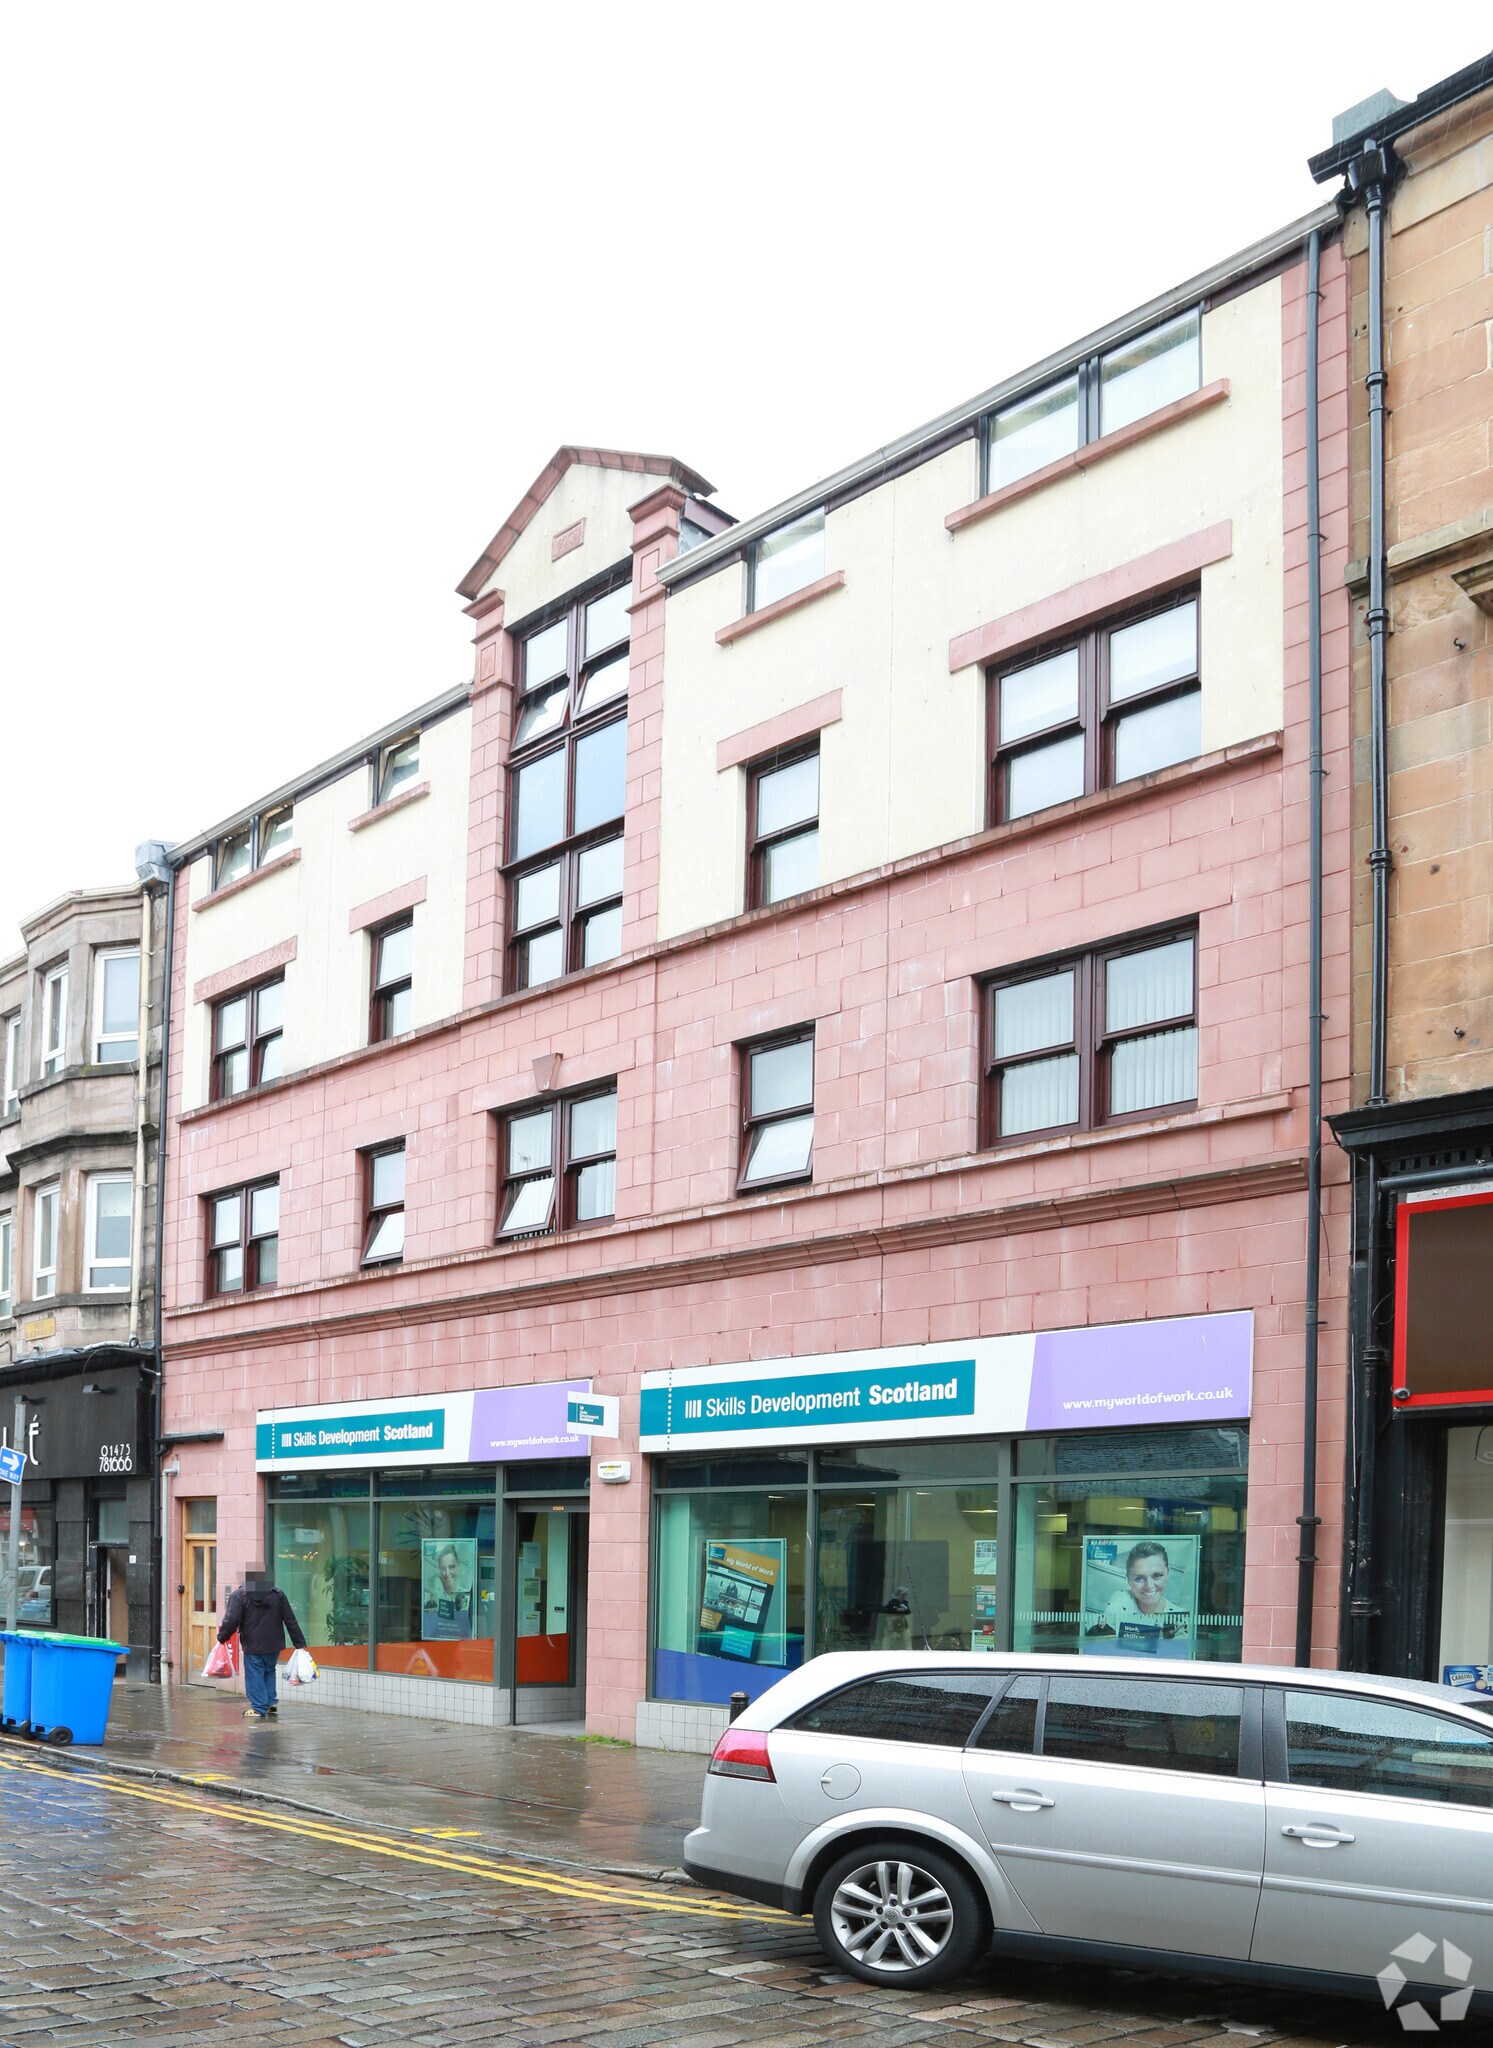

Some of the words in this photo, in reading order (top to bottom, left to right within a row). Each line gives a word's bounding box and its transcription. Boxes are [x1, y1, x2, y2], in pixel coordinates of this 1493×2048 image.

[705, 1398, 747, 1418] Skills
[750, 1387, 861, 1414] Development
[869, 1378, 958, 1406] Scotland
[1062, 1387, 1234, 1410] www.myworldofwork.co.uk
[293, 1431, 317, 1447] Skills
[318, 1426, 380, 1446] Development
[383, 1422, 433, 1440] Scotland
[489, 1433, 580, 1448] www.myworldofwork.co.uk
[100, 1444, 131, 1457] 01475
[99, 1456, 133, 1472] 781666
[726, 1557, 736, 1566] My
[735, 1559, 751, 1570] World
[758, 1567, 775, 1577] Work
